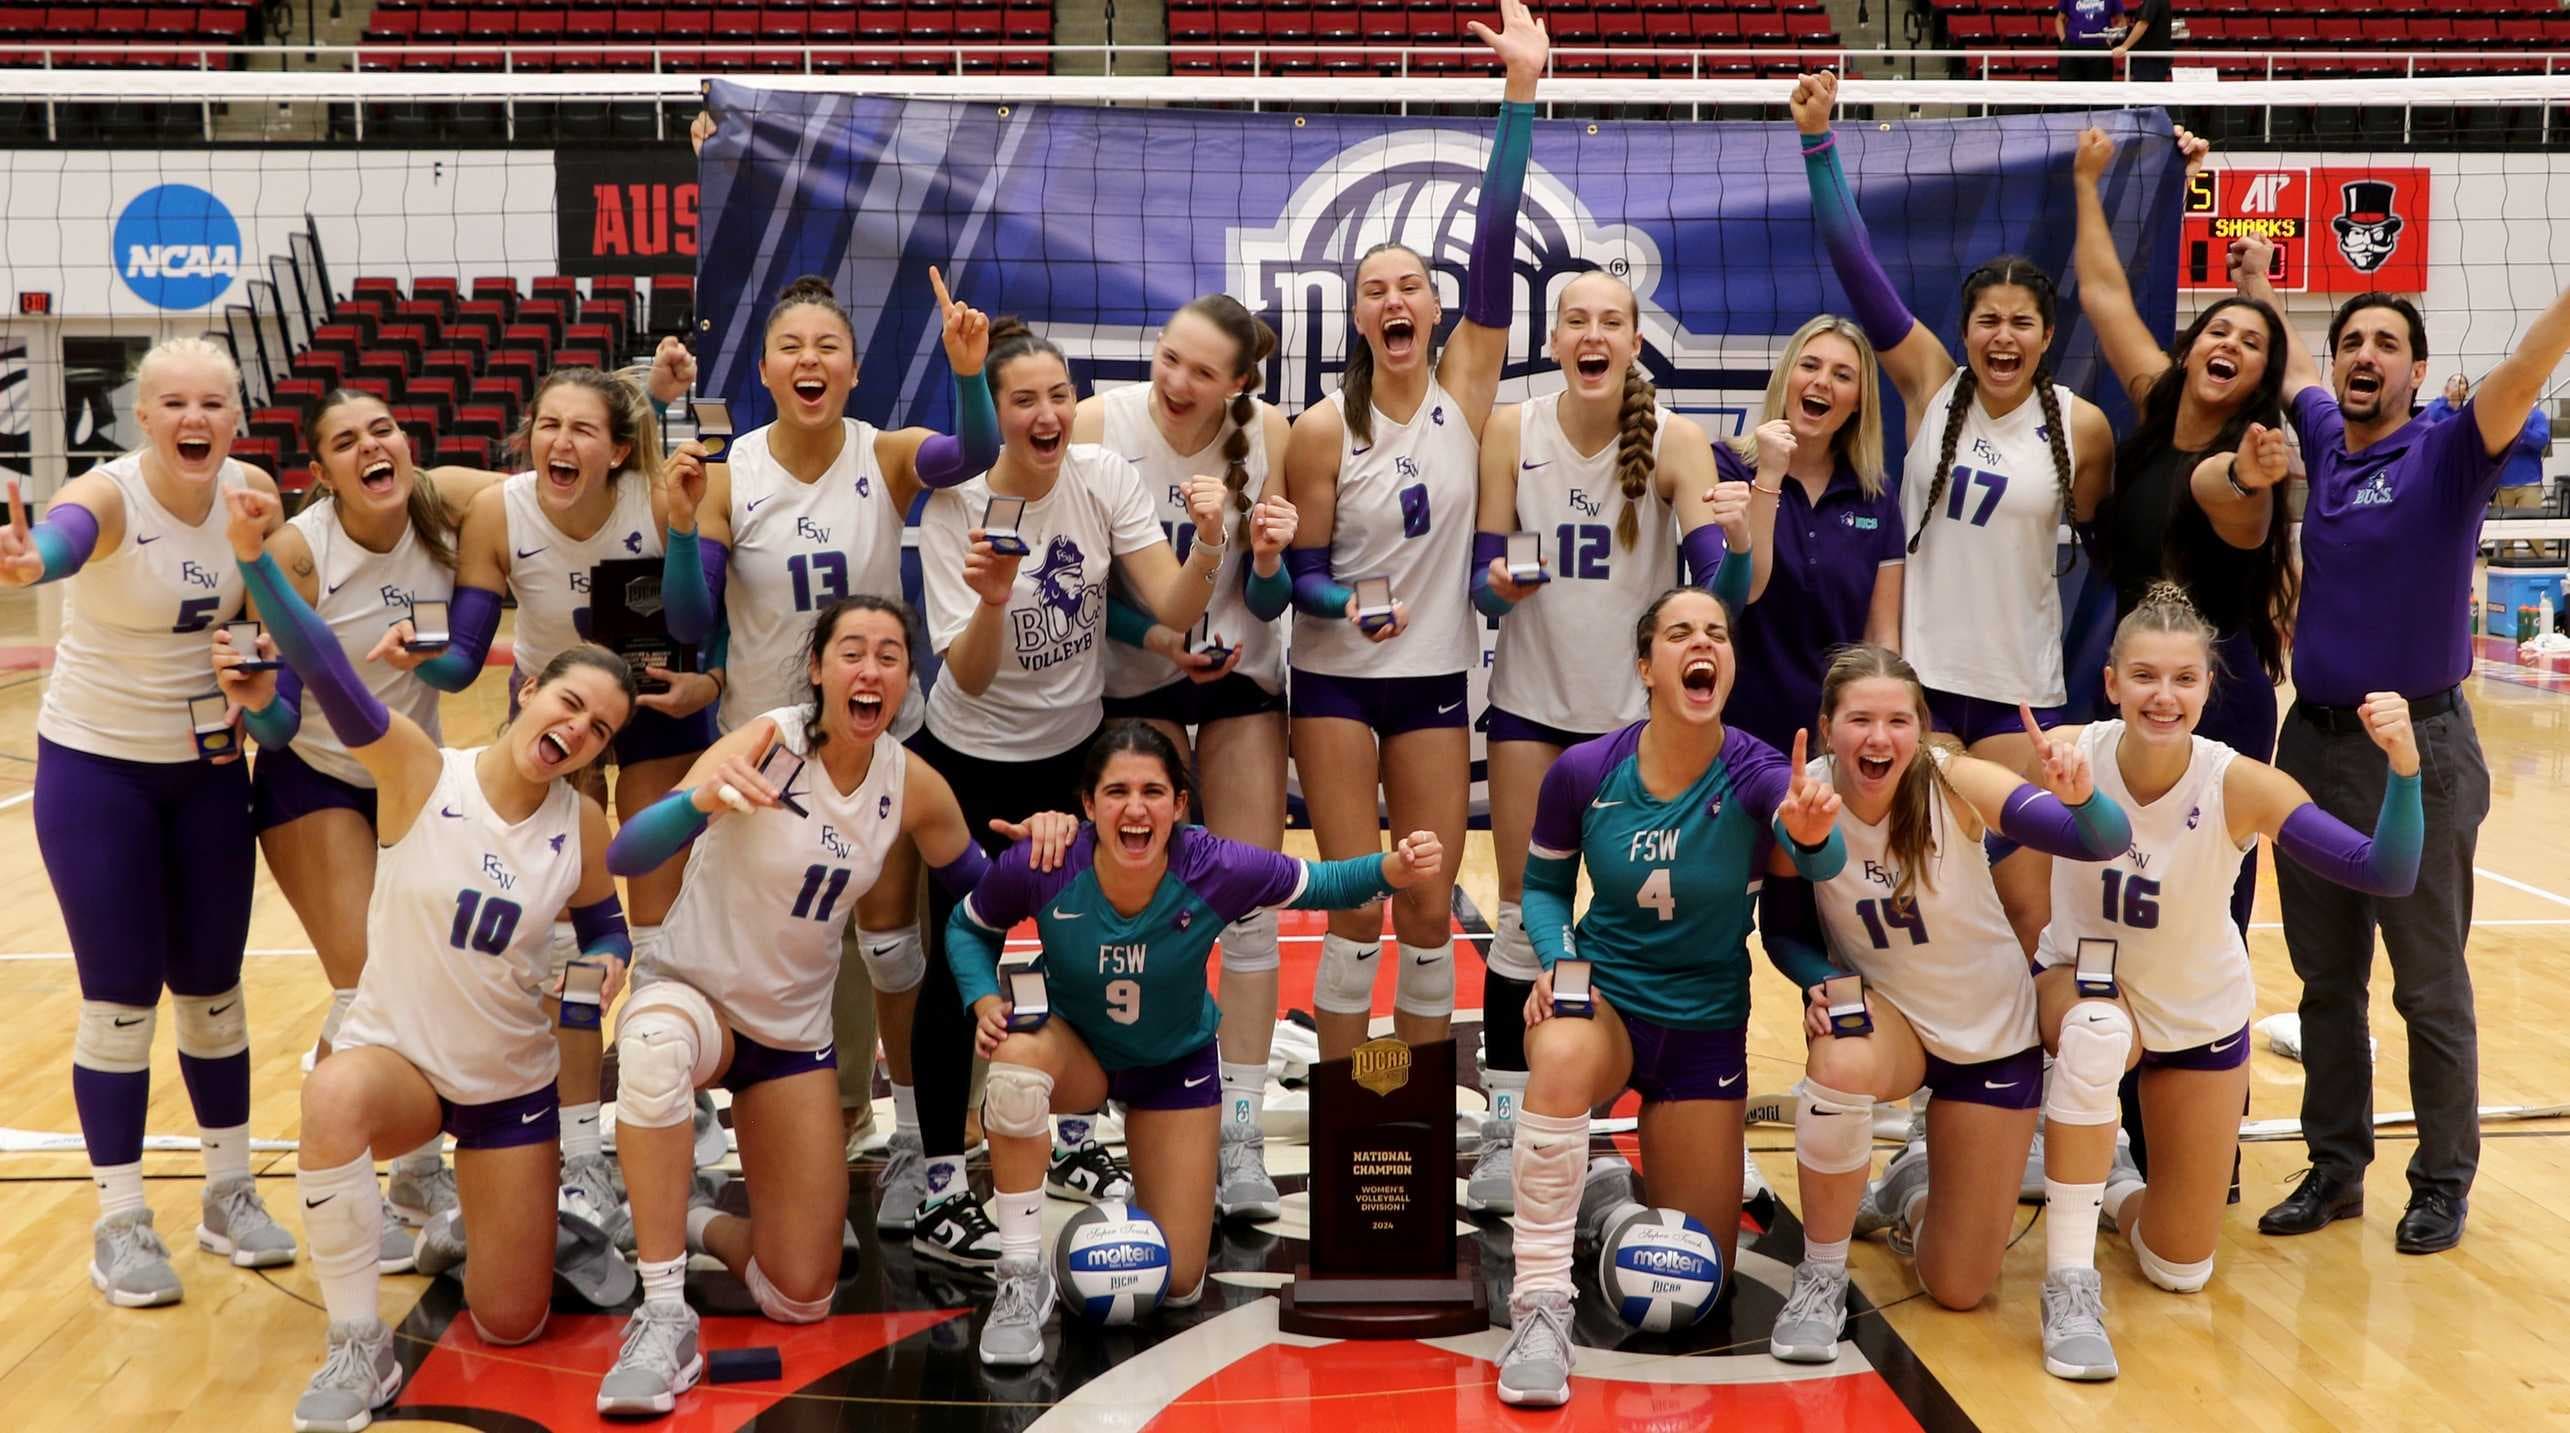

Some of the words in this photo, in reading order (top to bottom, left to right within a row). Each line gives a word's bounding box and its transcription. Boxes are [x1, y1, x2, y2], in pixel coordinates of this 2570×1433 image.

[592, 183, 699, 256] AUS
[2215, 218, 2297, 238] SHARKS
[126, 244, 239, 279] NCAA
[1972, 437, 2003, 466] FSW
[1395, 456, 1421, 478] FSW
[1168, 484, 1189, 513] FS
[1569, 488, 1600, 517] FSW
[1946, 465, 2009, 527] 17
[1399, 483, 1431, 539] 0
[797, 516, 831, 544] FSW
[1056, 549, 1075, 563] FSW
[1556, 523, 1612, 581] 12
[181, 560, 219, 589] FSW
[569, 572, 592, 594] FS
[787, 550, 849, 612] 13
[380, 584, 415, 608] FSW
[172, 596, 221, 634] 5
[1018, 630, 1095, 672] VOLLEYB
[821, 825, 852, 859] FSW
[1629, 828, 1681, 862] FSW
[2127, 842, 2151, 869] SW
[483, 853, 516, 890] FSW
[1863, 860, 1899, 889] FSW
[791, 864, 852, 922] 11
[1636, 868, 1676, 921] 4
[2101, 868, 2160, 929] 16
[450, 888, 522, 956] 10
[1856, 895, 1929, 949] 14
[1098, 944, 1147, 975] FSW
[1105, 979, 1141, 1026] 9
[1353, 1049, 1409, 1077] NJCAA
[1353, 1151, 1412, 1162] NATIONAL
[1353, 1165, 1412, 1176] CHAMPION
[1356, 1194, 1411, 1203] VOLLEYBALL
[1361, 1186, 1405, 1194] WOMEN'S
[1361, 1203, 1400, 1212] DIVISION
[1372, 1221, 1394, 1230] 2024
[1088, 1244, 1155, 1266] molten
[1633, 1250, 1705, 1274] molten
